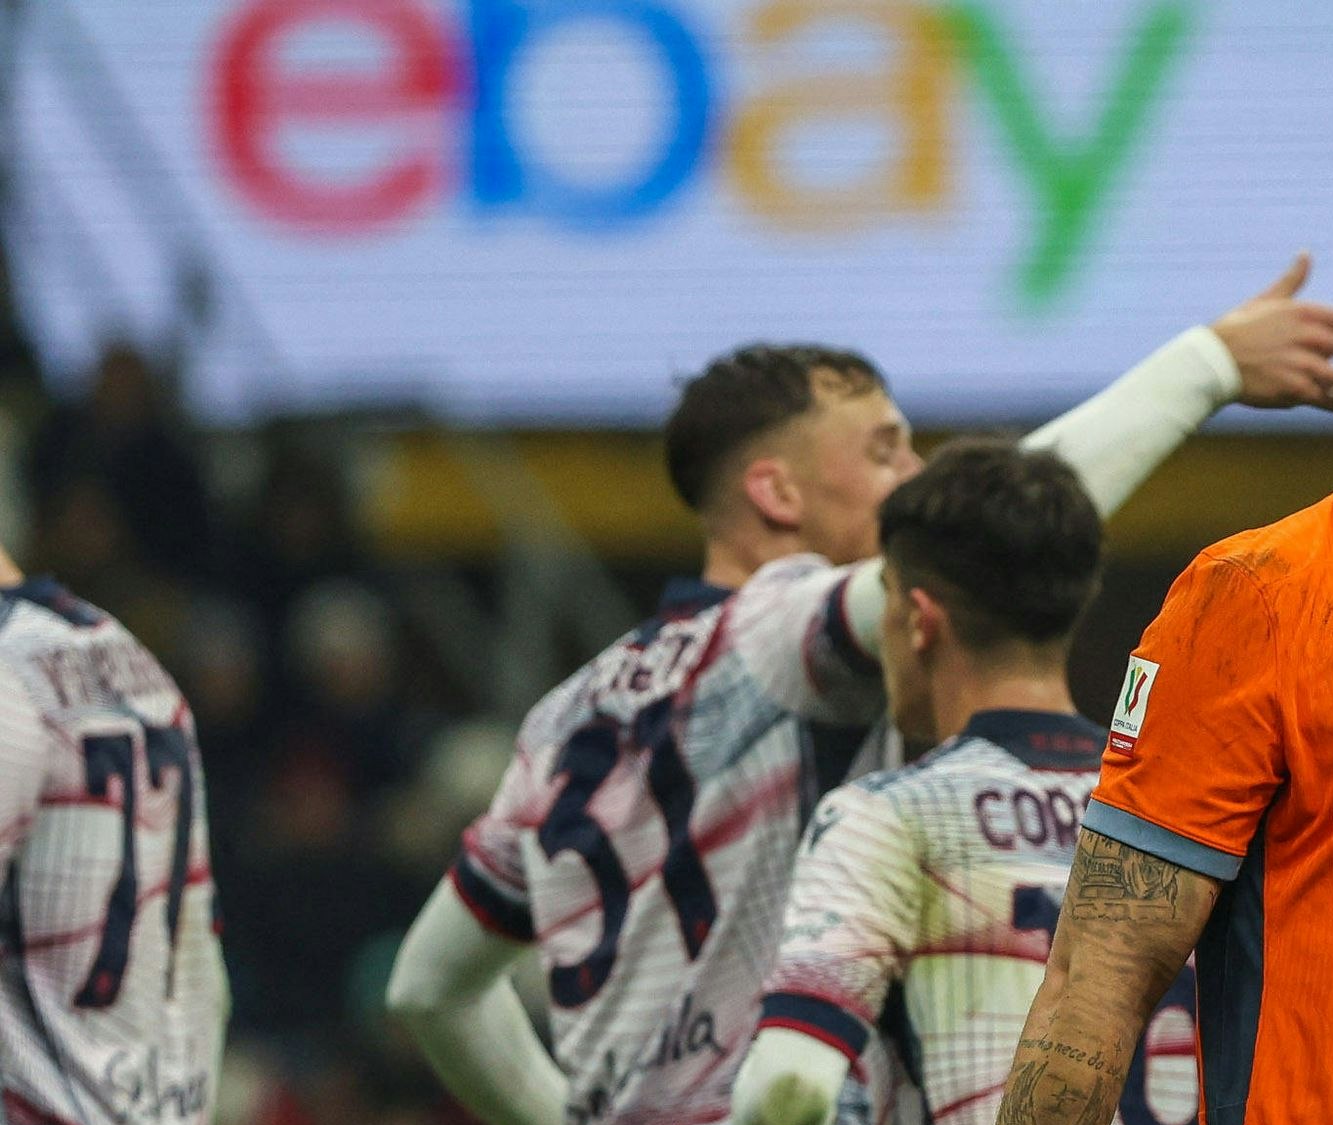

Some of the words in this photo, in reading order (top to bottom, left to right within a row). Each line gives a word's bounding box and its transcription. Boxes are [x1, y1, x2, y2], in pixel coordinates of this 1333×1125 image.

[202, 0, 1196, 312] ebay
[75, 724, 193, 1010] 77
[537, 698, 718, 1009] 31
